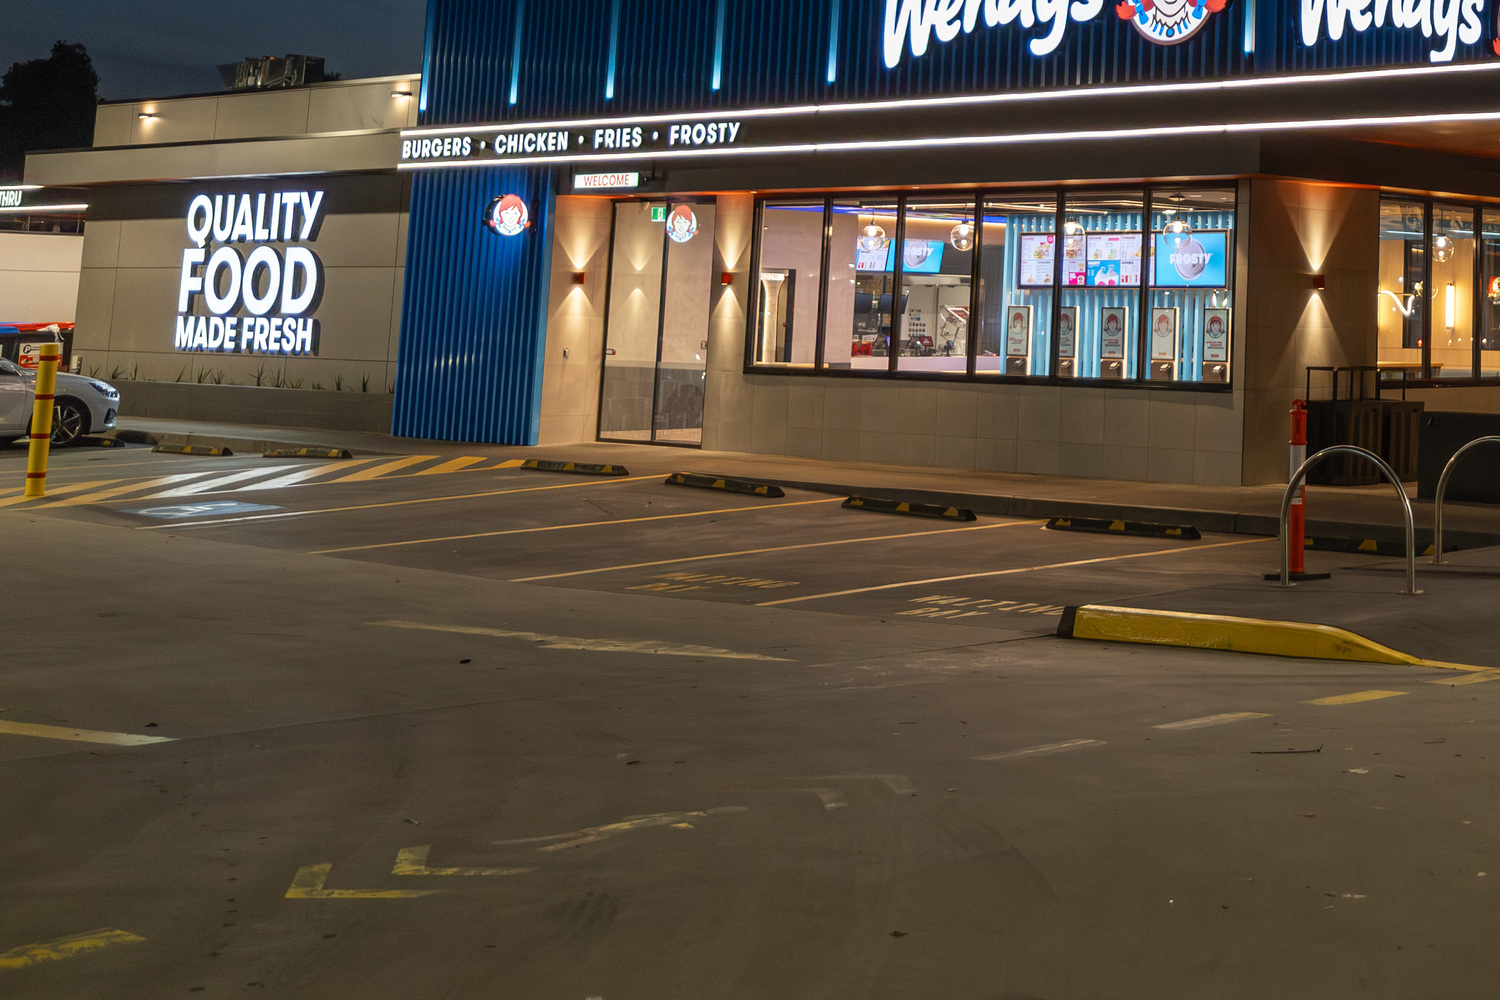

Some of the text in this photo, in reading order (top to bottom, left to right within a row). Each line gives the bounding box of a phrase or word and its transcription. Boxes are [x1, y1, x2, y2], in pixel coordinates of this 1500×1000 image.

[402, 122, 741, 158] BURGERS CHICKEN FRIES FROSTY
[584, 174, 629, 186] WELCOME
[187, 190, 324, 248] QUALITY
[904, 247, 934, 257] ROSTY
[1170, 253, 1212, 264] FROSTY
[178, 246, 317, 315] FOOD
[175, 316, 314, 353] MADE FRESH
